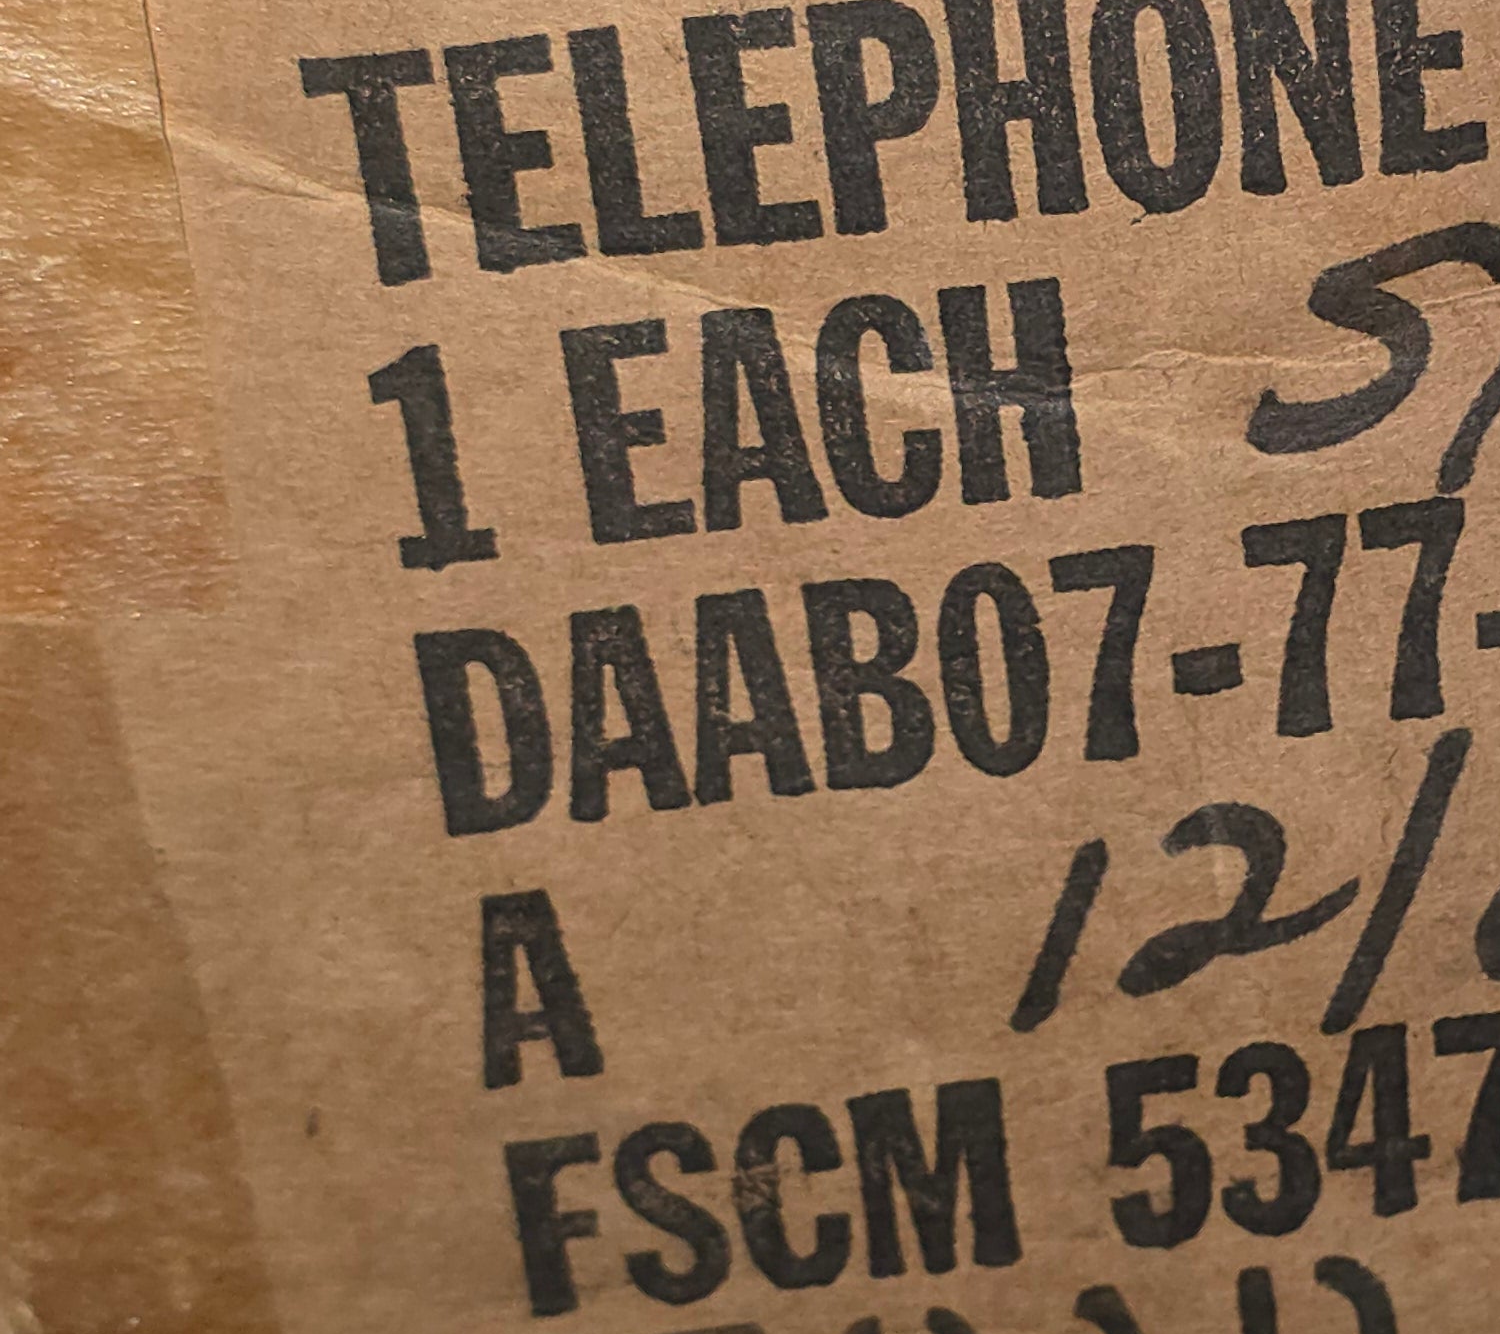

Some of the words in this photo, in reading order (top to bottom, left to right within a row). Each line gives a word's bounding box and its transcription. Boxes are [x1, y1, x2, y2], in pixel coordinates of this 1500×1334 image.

[368, 344, 499, 571] 1
[560, 277, 1082, 545] EACH
[480, 889, 603, 1088] A
[503, 1077, 1021, 1317] FSCM
